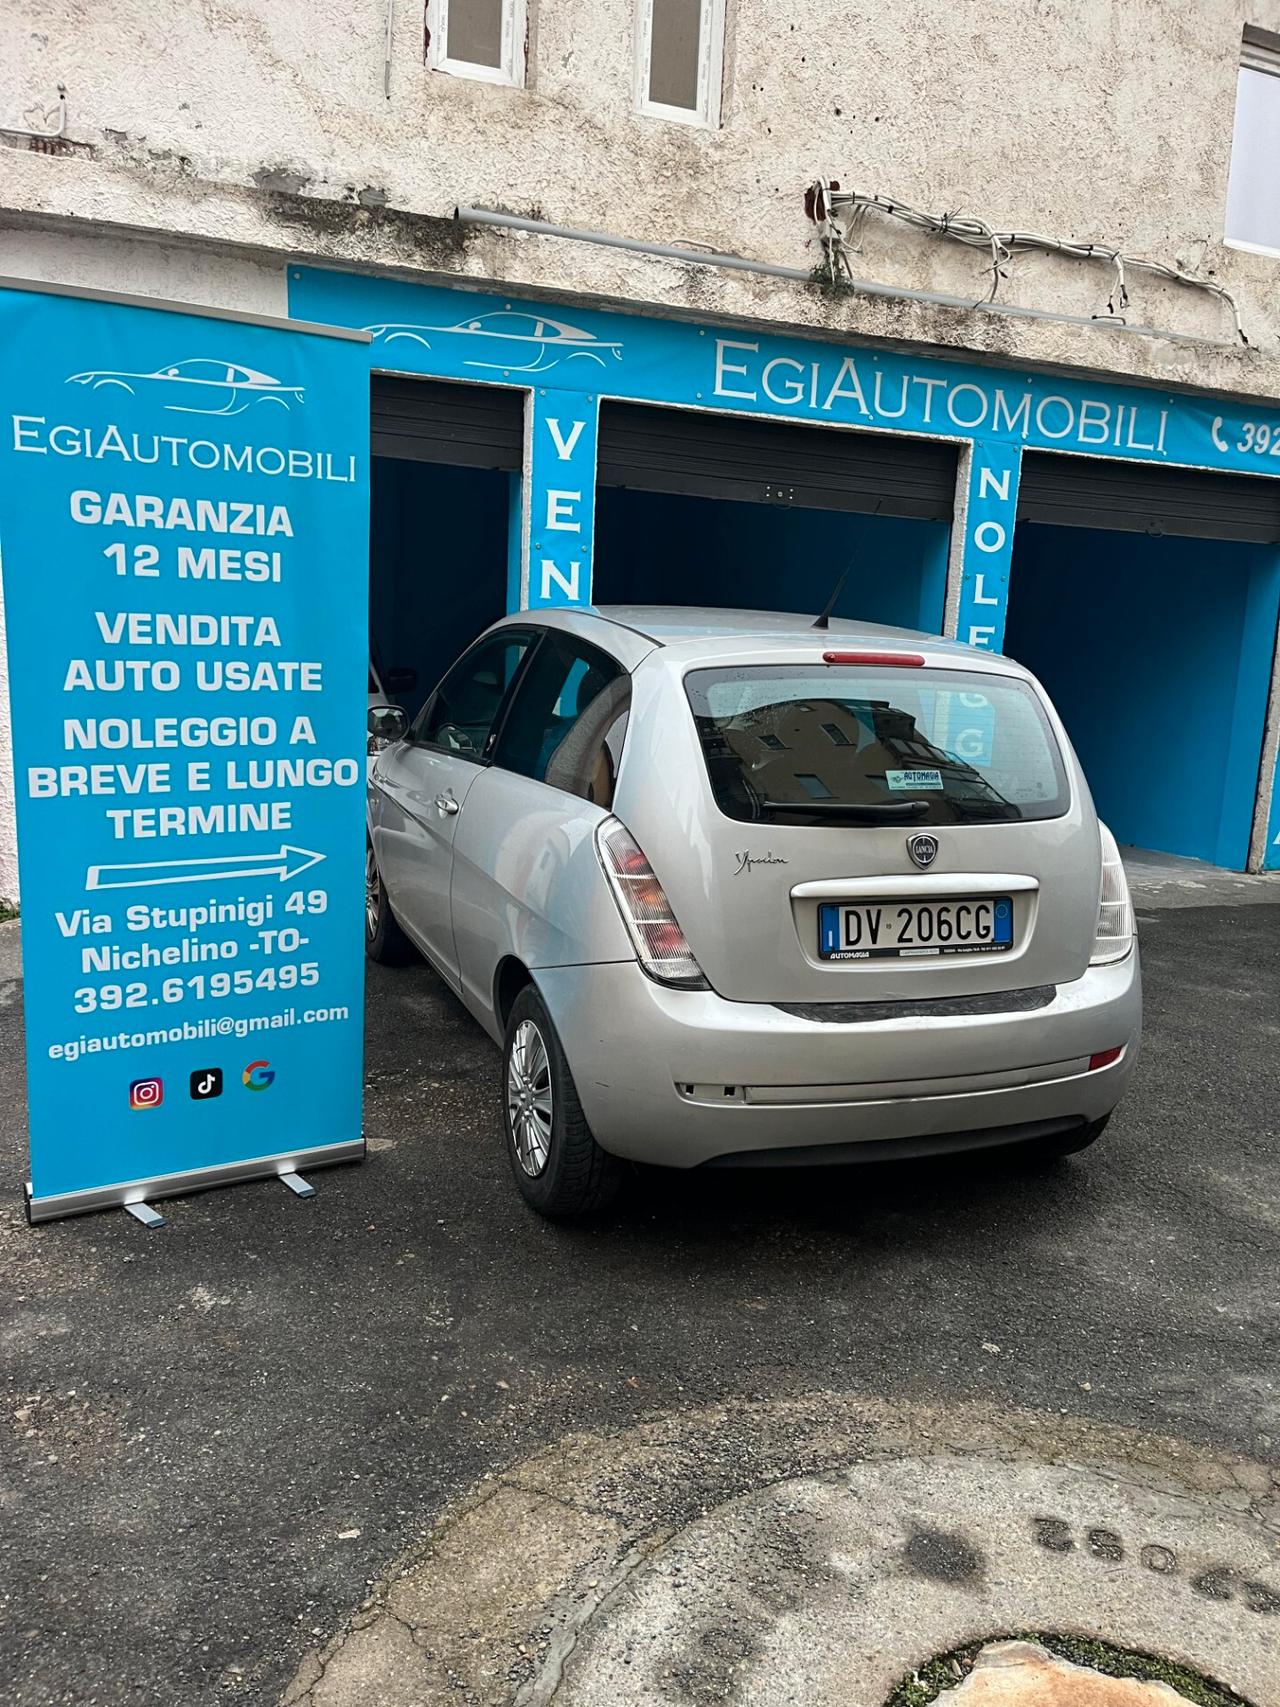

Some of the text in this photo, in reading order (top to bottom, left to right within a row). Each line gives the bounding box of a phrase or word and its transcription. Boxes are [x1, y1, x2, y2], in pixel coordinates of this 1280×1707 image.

[70, 490, 294, 537] GARANZIA
[103, 543, 281, 582] 12 MESI
[94, 612, 281, 646] VENDITA
[63, 660, 322, 691] AUTO USATE
[63, 716, 317, 750] NOLEGGIO A
[28, 759, 358, 798] BREVE E LUNGO
[106, 802, 292, 839] TERMINE
[55, 890, 328, 937] Via Stupinigi 49
[845, 909, 882, 946] DV
[897, 904, 991, 944] 206CG
[81, 928, 309, 973] Nichelino -TO-
[74, 962, 320, 1013] 392.6195495
[48, 1005, 349, 1062] egiautomobili@gmail.com
